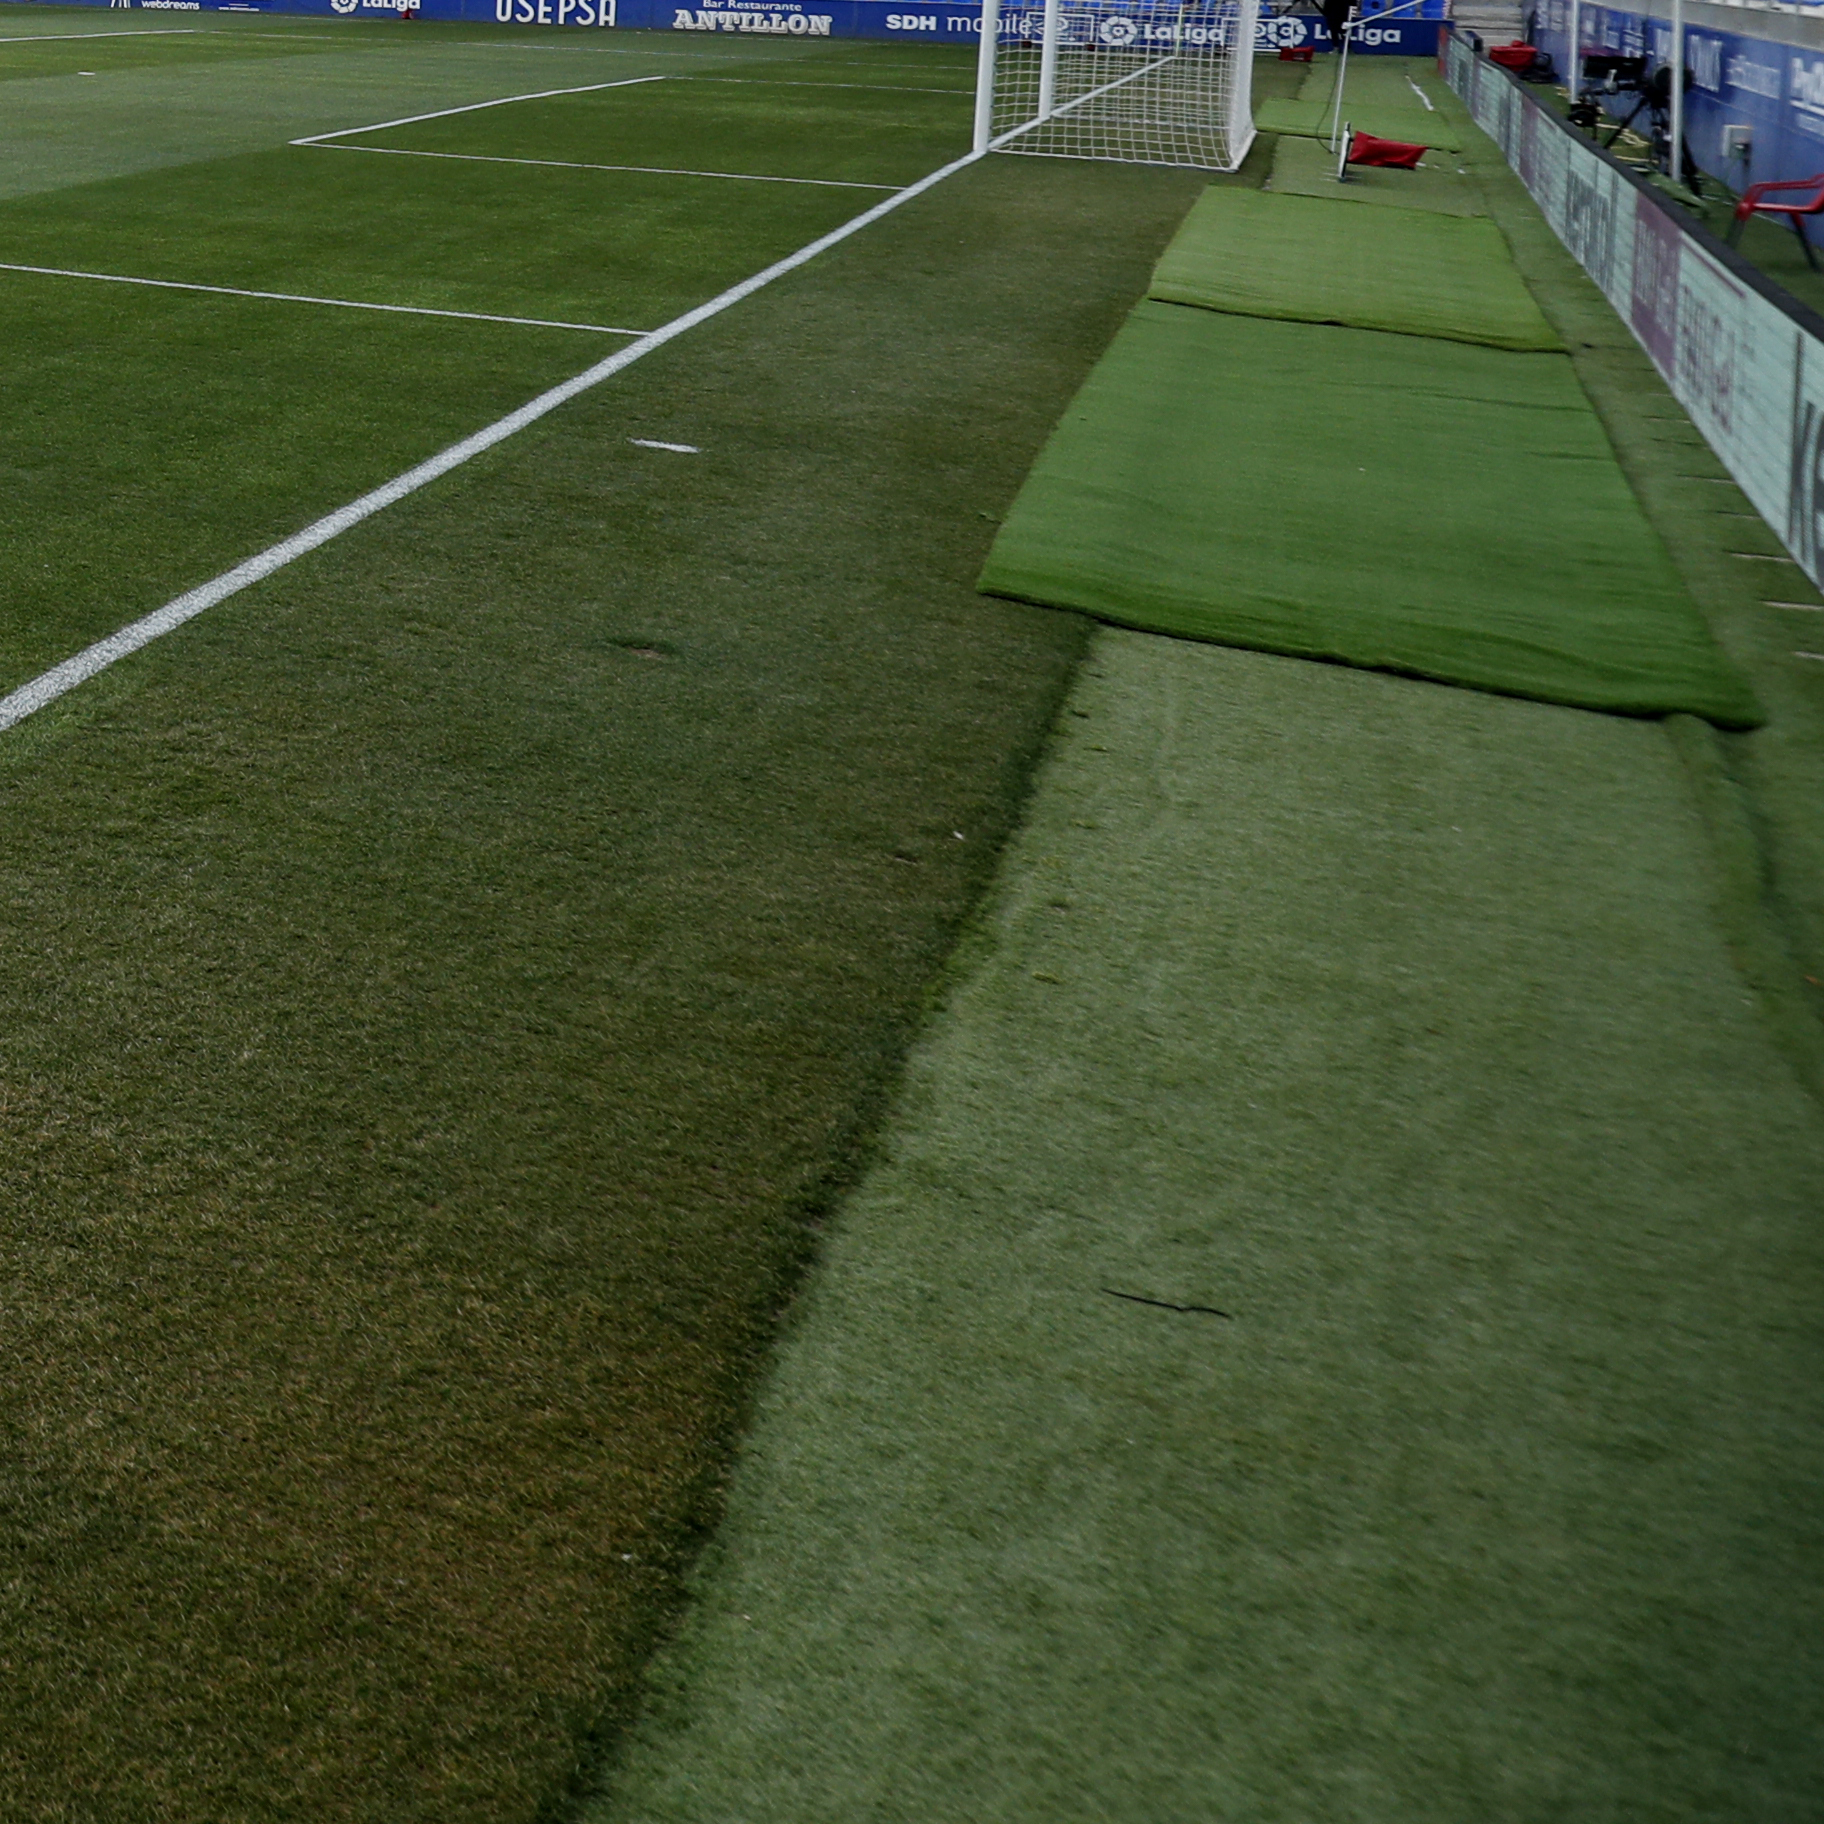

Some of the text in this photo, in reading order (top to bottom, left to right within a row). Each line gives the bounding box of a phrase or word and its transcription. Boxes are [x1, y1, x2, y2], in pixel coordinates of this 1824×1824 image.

[728, 0, 802, 12] Restaurante
[672, 9, 834, 36] ANTILLON
[886, 13, 937, 31] SDH
